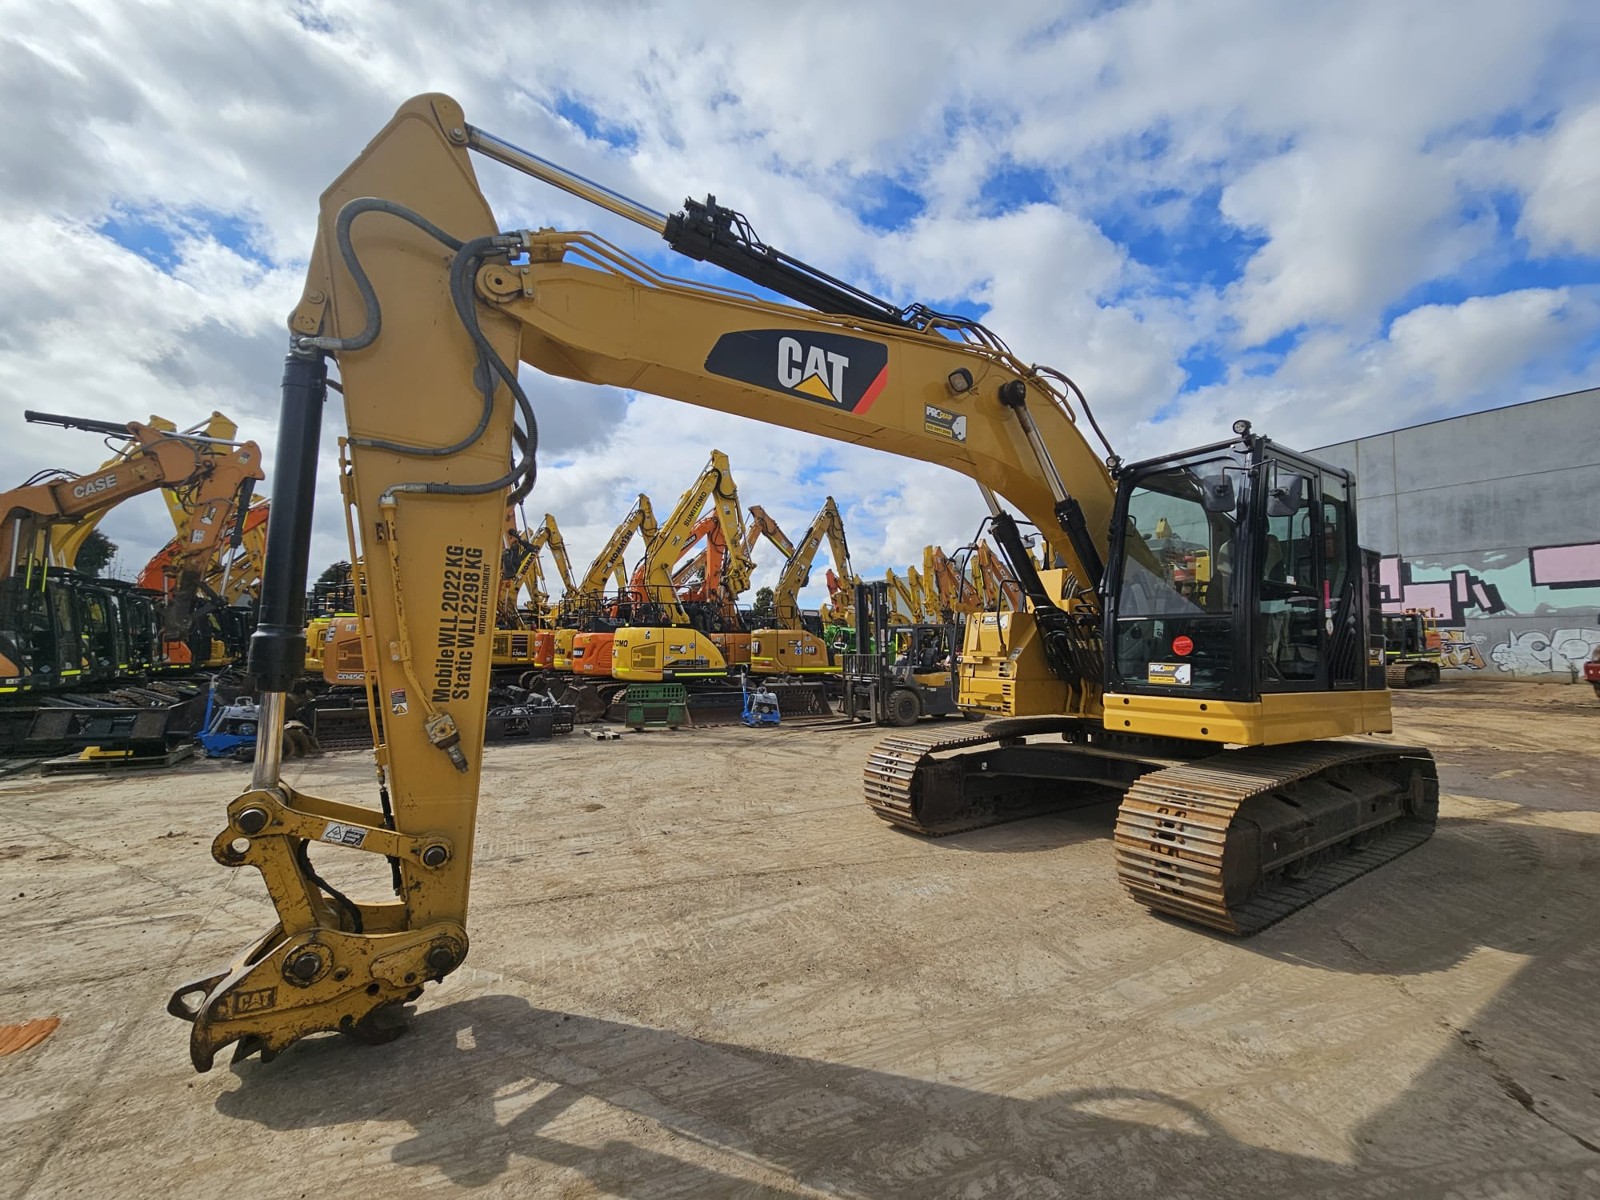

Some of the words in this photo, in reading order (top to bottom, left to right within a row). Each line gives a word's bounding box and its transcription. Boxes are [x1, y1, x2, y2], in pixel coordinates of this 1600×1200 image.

[778, 336, 849, 403] CAT
[73, 474, 118, 499] CASE
[683, 491, 707, 527] SUMITOMO
[445, 545, 464, 568] KG
[464, 548, 483, 570] KG
[610, 530, 633, 564] KOMATSU
[441, 570, 462, 612] 2022
[461, 572, 481, 615] 2298
[481, 563, 491, 605] ATTACHMENT
[438, 616, 458, 648] WLL
[457, 617, 476, 649] WLL
[478, 606, 488, 635] WITHOUT
[432, 649, 455, 702] Mobile
[451, 651, 473, 700] Static
